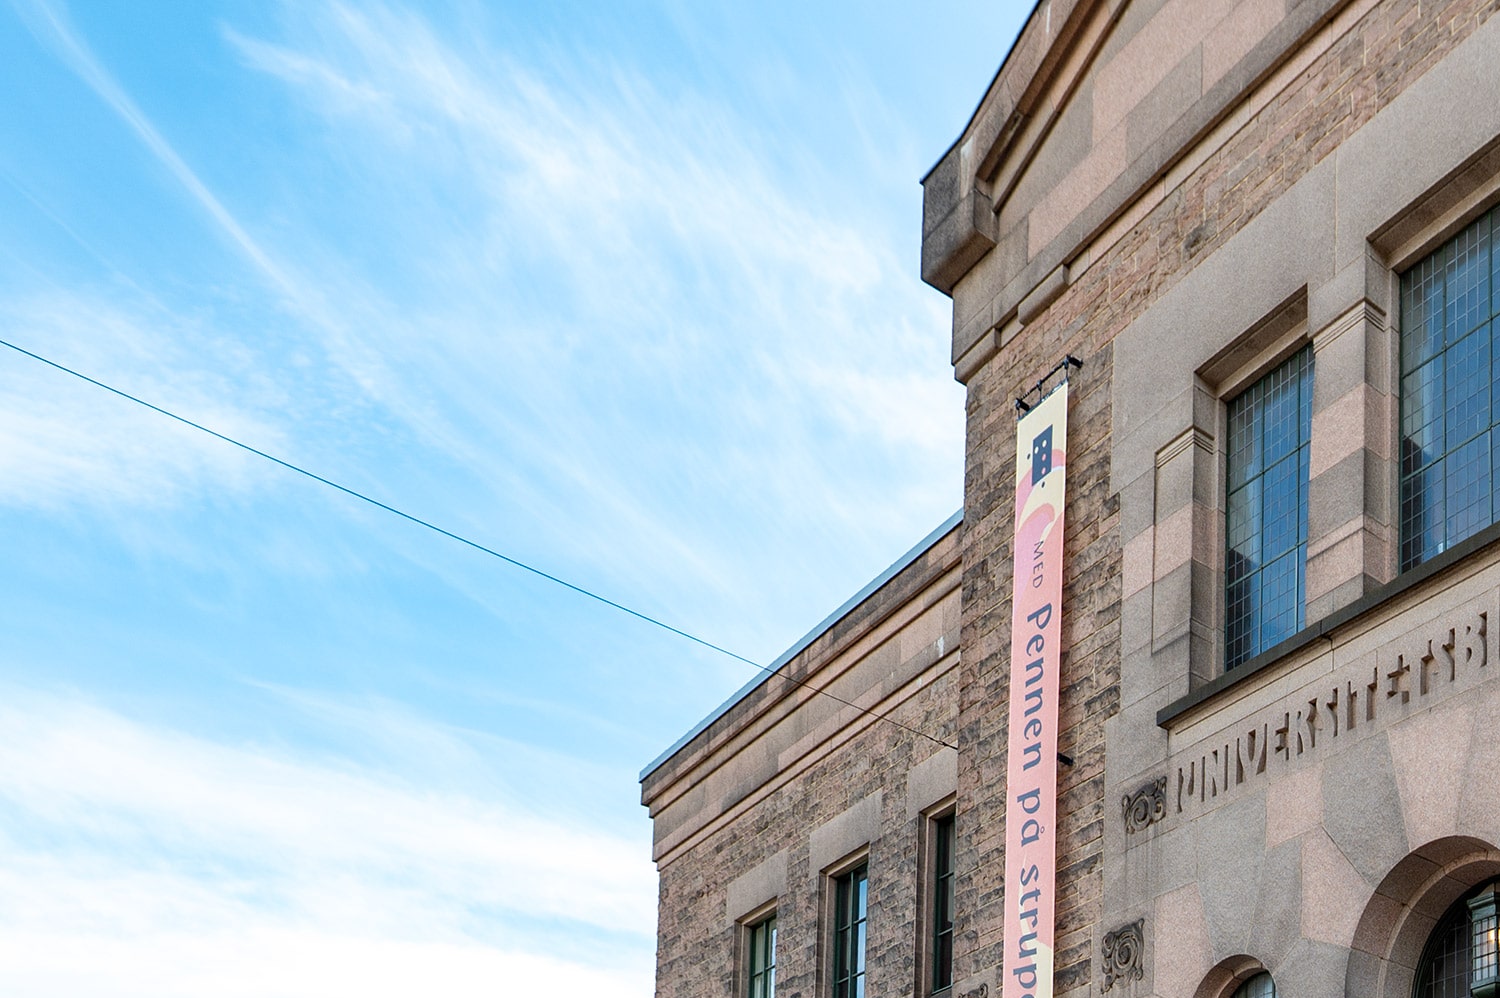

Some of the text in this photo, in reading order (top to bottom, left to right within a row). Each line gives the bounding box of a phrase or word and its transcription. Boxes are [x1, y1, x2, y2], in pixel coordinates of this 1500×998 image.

[1032, 540, 1044, 589] MED
[1022, 602, 1052, 771] Pennen
[1016, 787, 1045, 848] på
